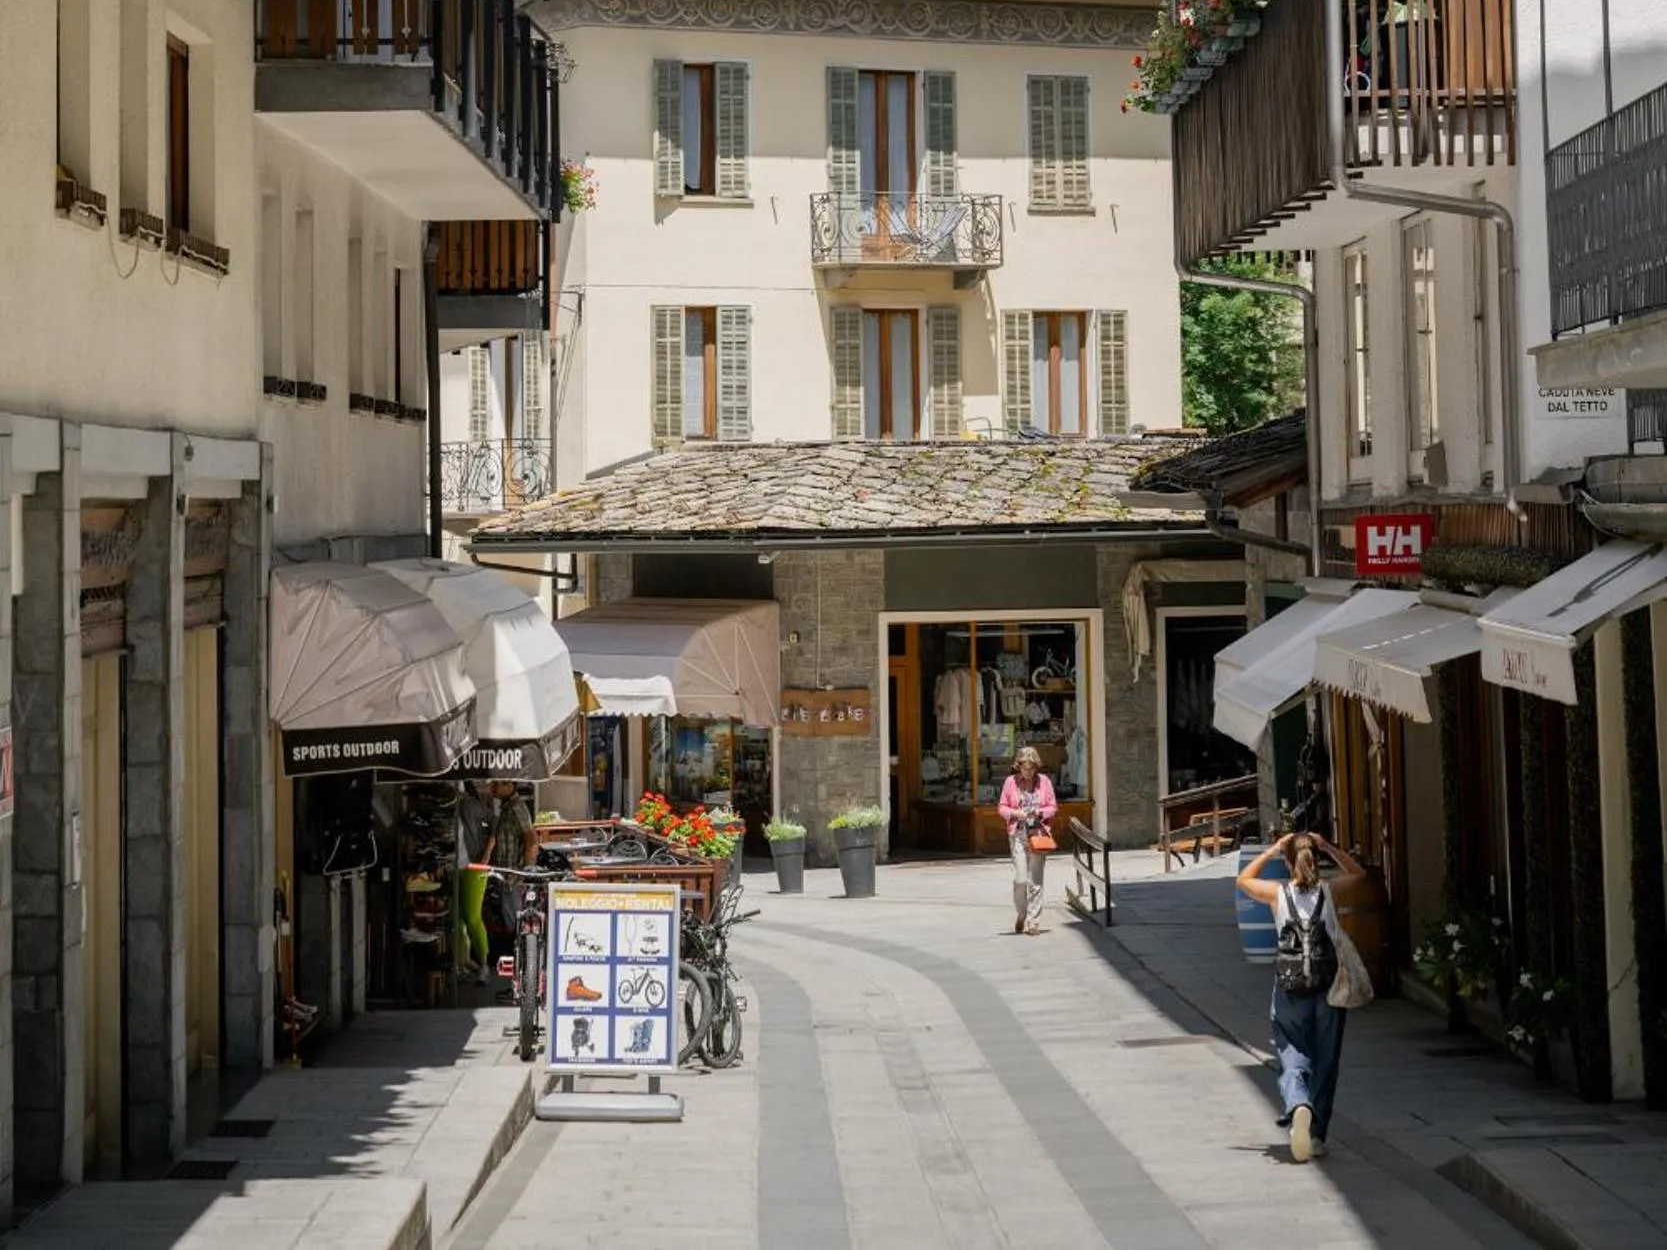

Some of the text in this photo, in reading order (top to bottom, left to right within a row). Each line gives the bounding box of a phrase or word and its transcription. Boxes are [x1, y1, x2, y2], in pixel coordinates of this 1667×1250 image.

[1538, 387, 1615, 398] CADUTA NEVE
[1547, 400, 1608, 413] DAL TETTO
[292, 739, 400, 761] SPORTS OUTDOOR
[463, 749, 523, 770] OUTDOOR
